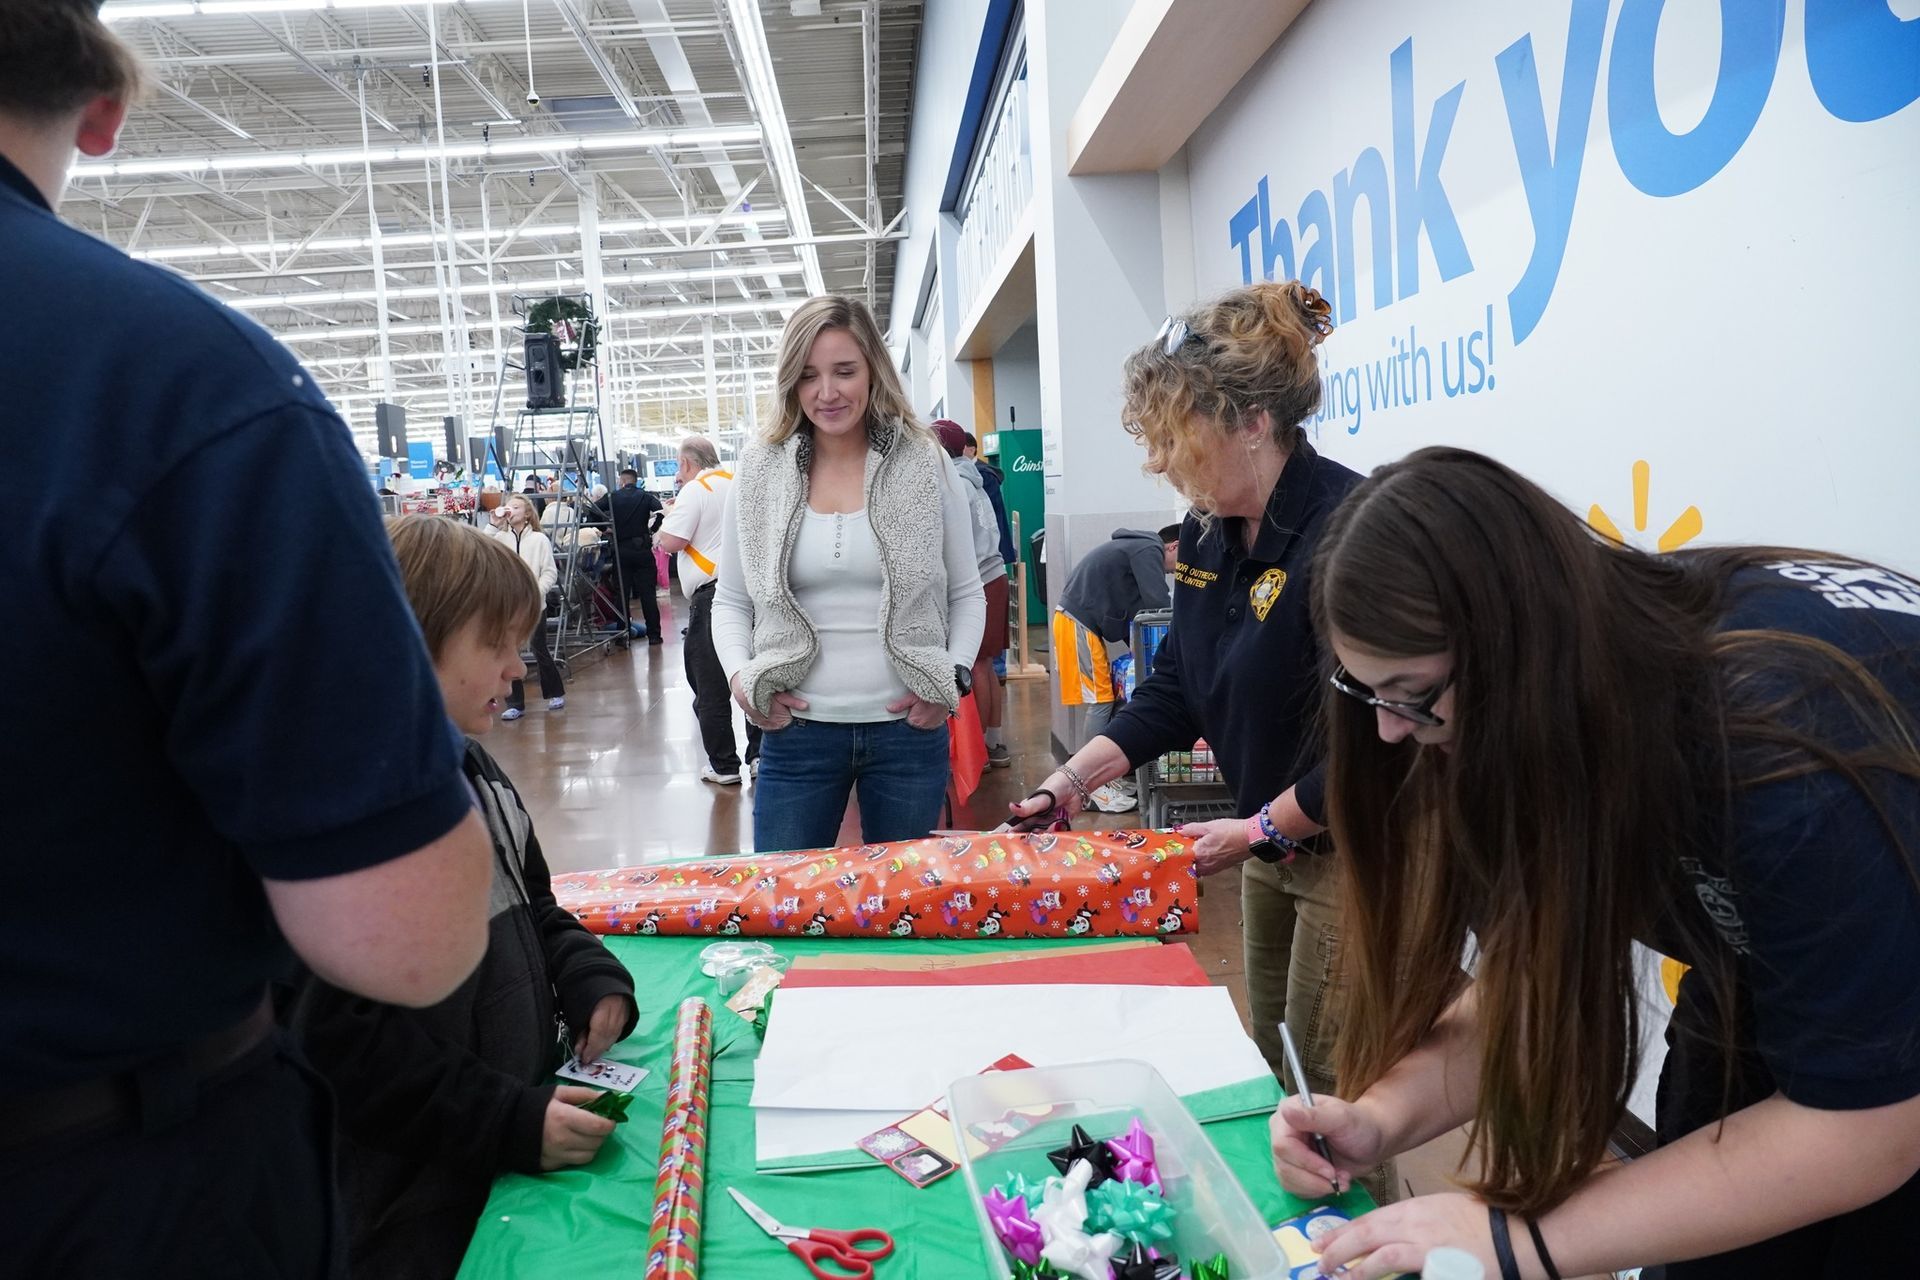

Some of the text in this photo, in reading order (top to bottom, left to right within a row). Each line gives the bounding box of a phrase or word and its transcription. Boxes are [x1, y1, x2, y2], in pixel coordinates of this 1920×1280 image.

[1229, 36, 1474, 327] Thank
[1366, 325, 1432, 412] with
[1441, 304, 1496, 398] us!
